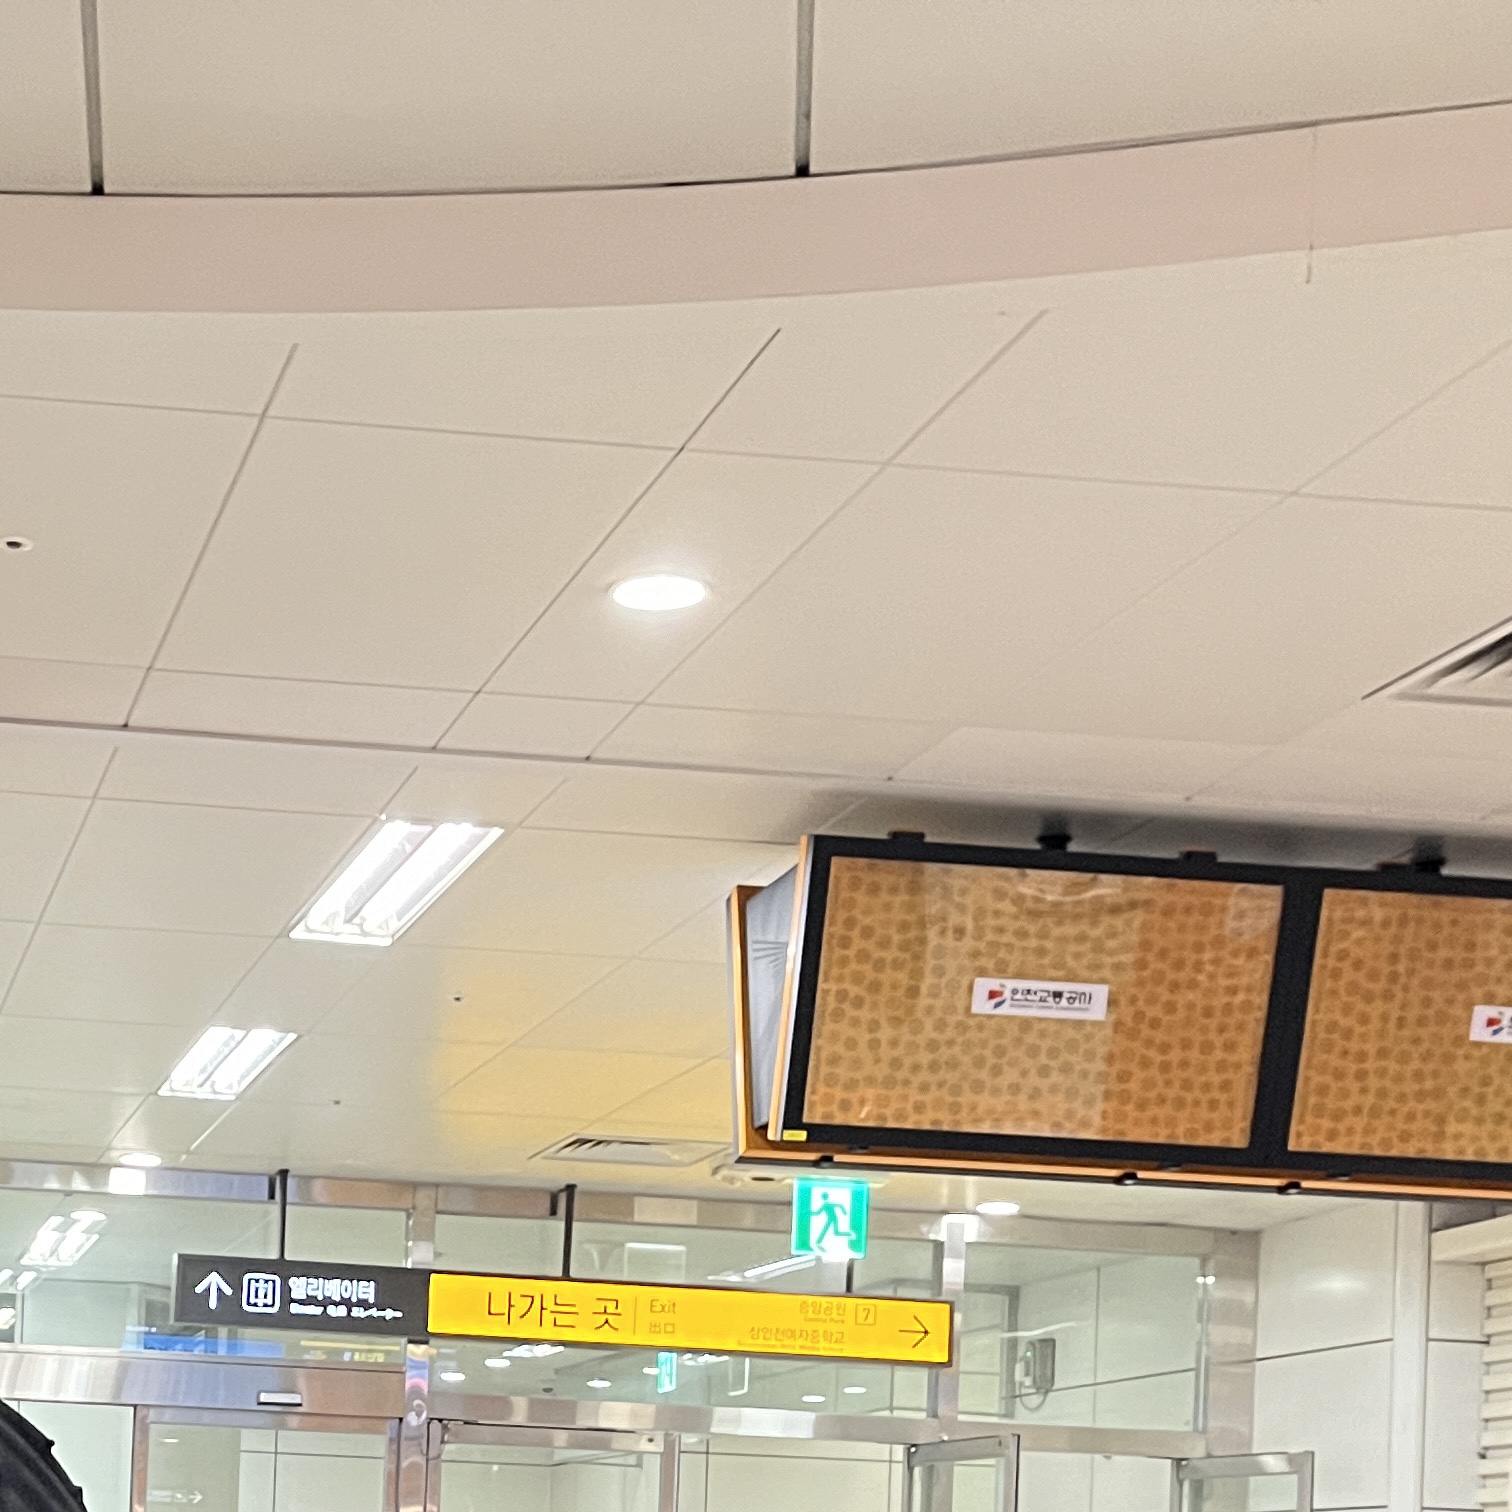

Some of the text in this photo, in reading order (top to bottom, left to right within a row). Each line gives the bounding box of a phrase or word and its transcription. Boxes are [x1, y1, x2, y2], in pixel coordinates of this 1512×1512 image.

[288, 1276, 376, 1303] 엘리베이터
[487, 1291, 622, 1332] 나가는 곳
[649, 1298, 677, 1315] Exit
[862, 1307, 872, 1323] 7
[648, 1321, 676, 1335] 出口
